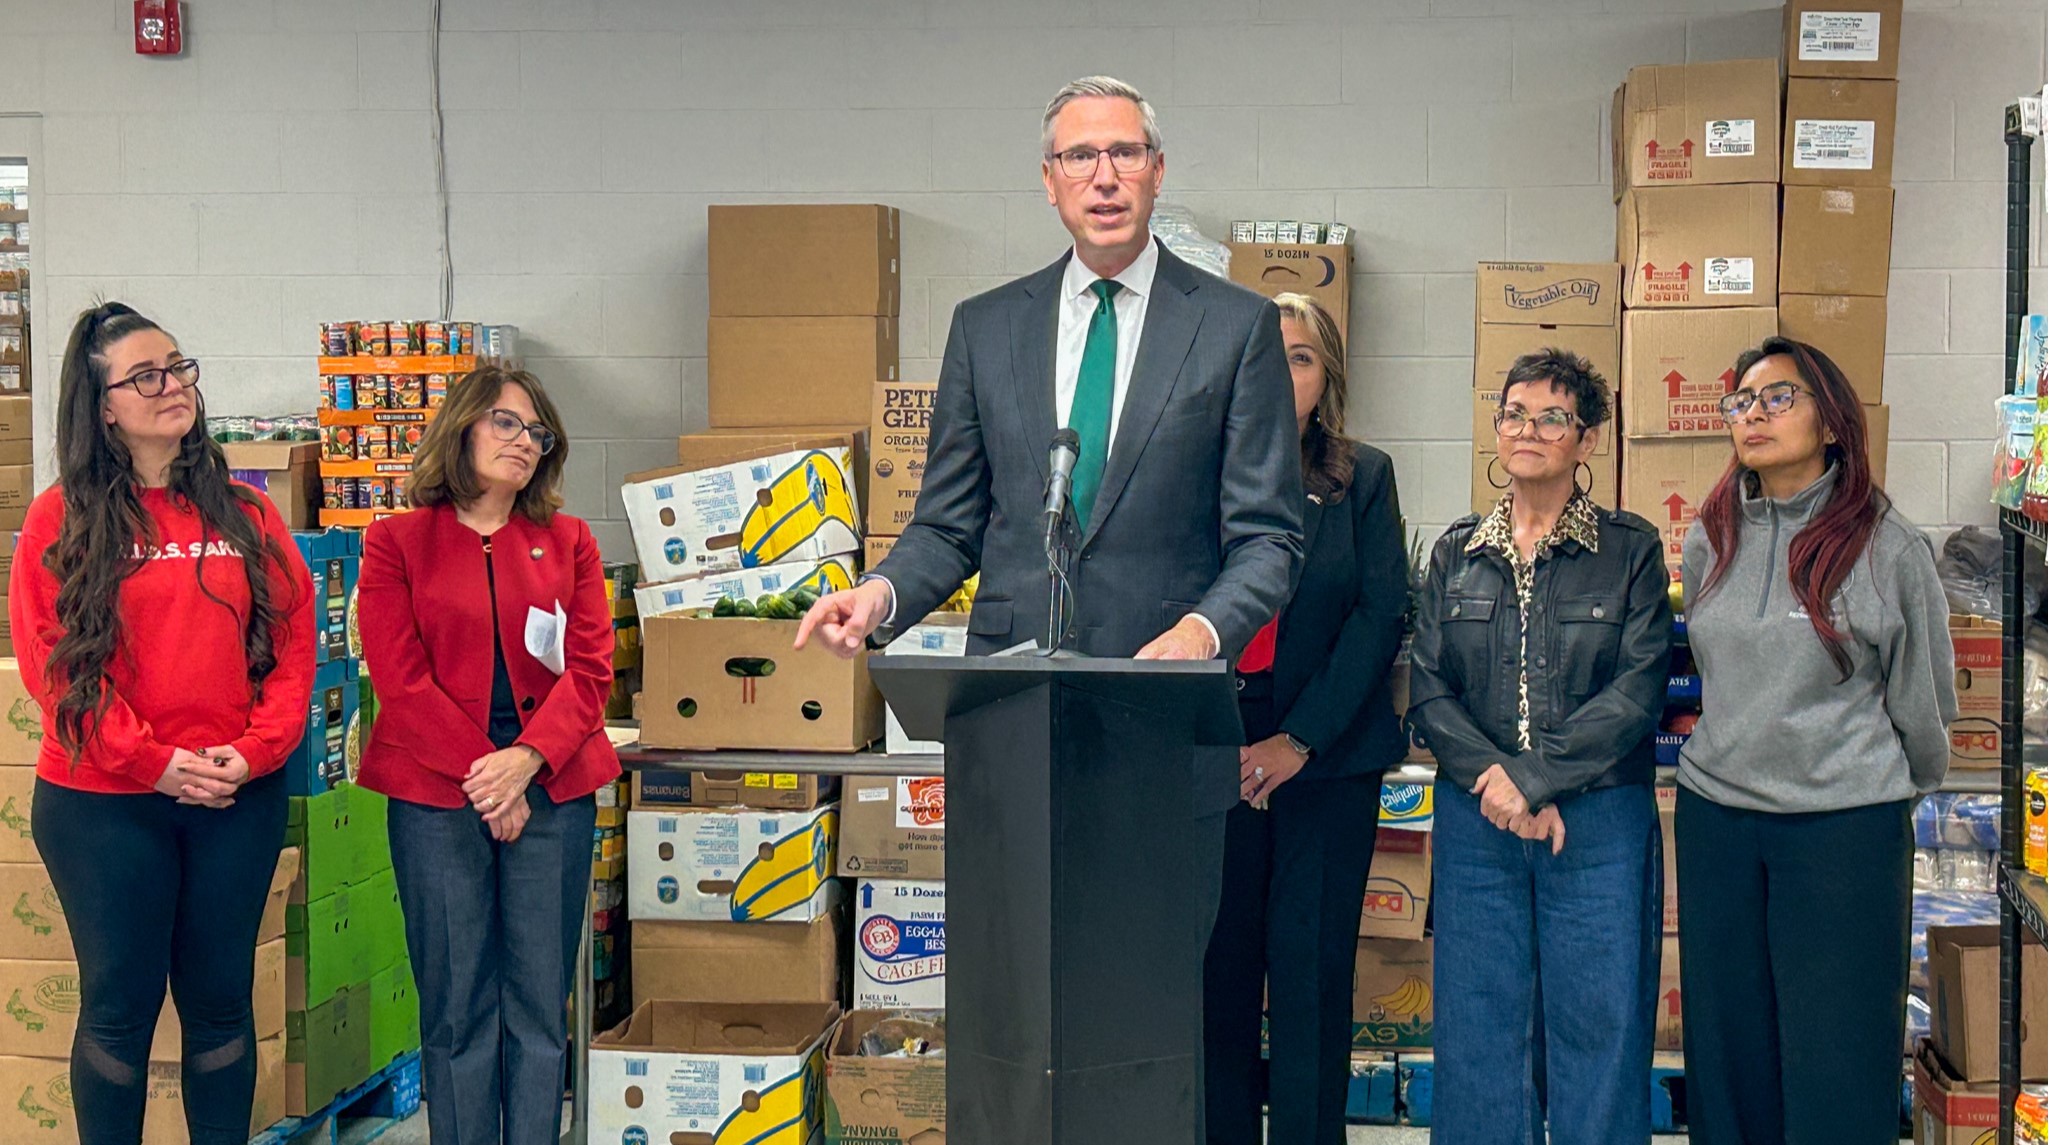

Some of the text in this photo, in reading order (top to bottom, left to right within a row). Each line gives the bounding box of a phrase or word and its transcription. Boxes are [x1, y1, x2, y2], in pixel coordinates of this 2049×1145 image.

[1511, 281, 1592, 308] Vegetable Oil
[883, 409, 933, 428] GER
[884, 435, 929, 446] ORGAN
[1953, 734, 1996, 751] Dole
[642, 784, 691, 797] Bananas
[1380, 784, 1424, 808] Chiquita
[894, 887, 945, 897] 15 Doze
[877, 959, 924, 979] CAGE
[842, 1125, 898, 1137] BANANA
